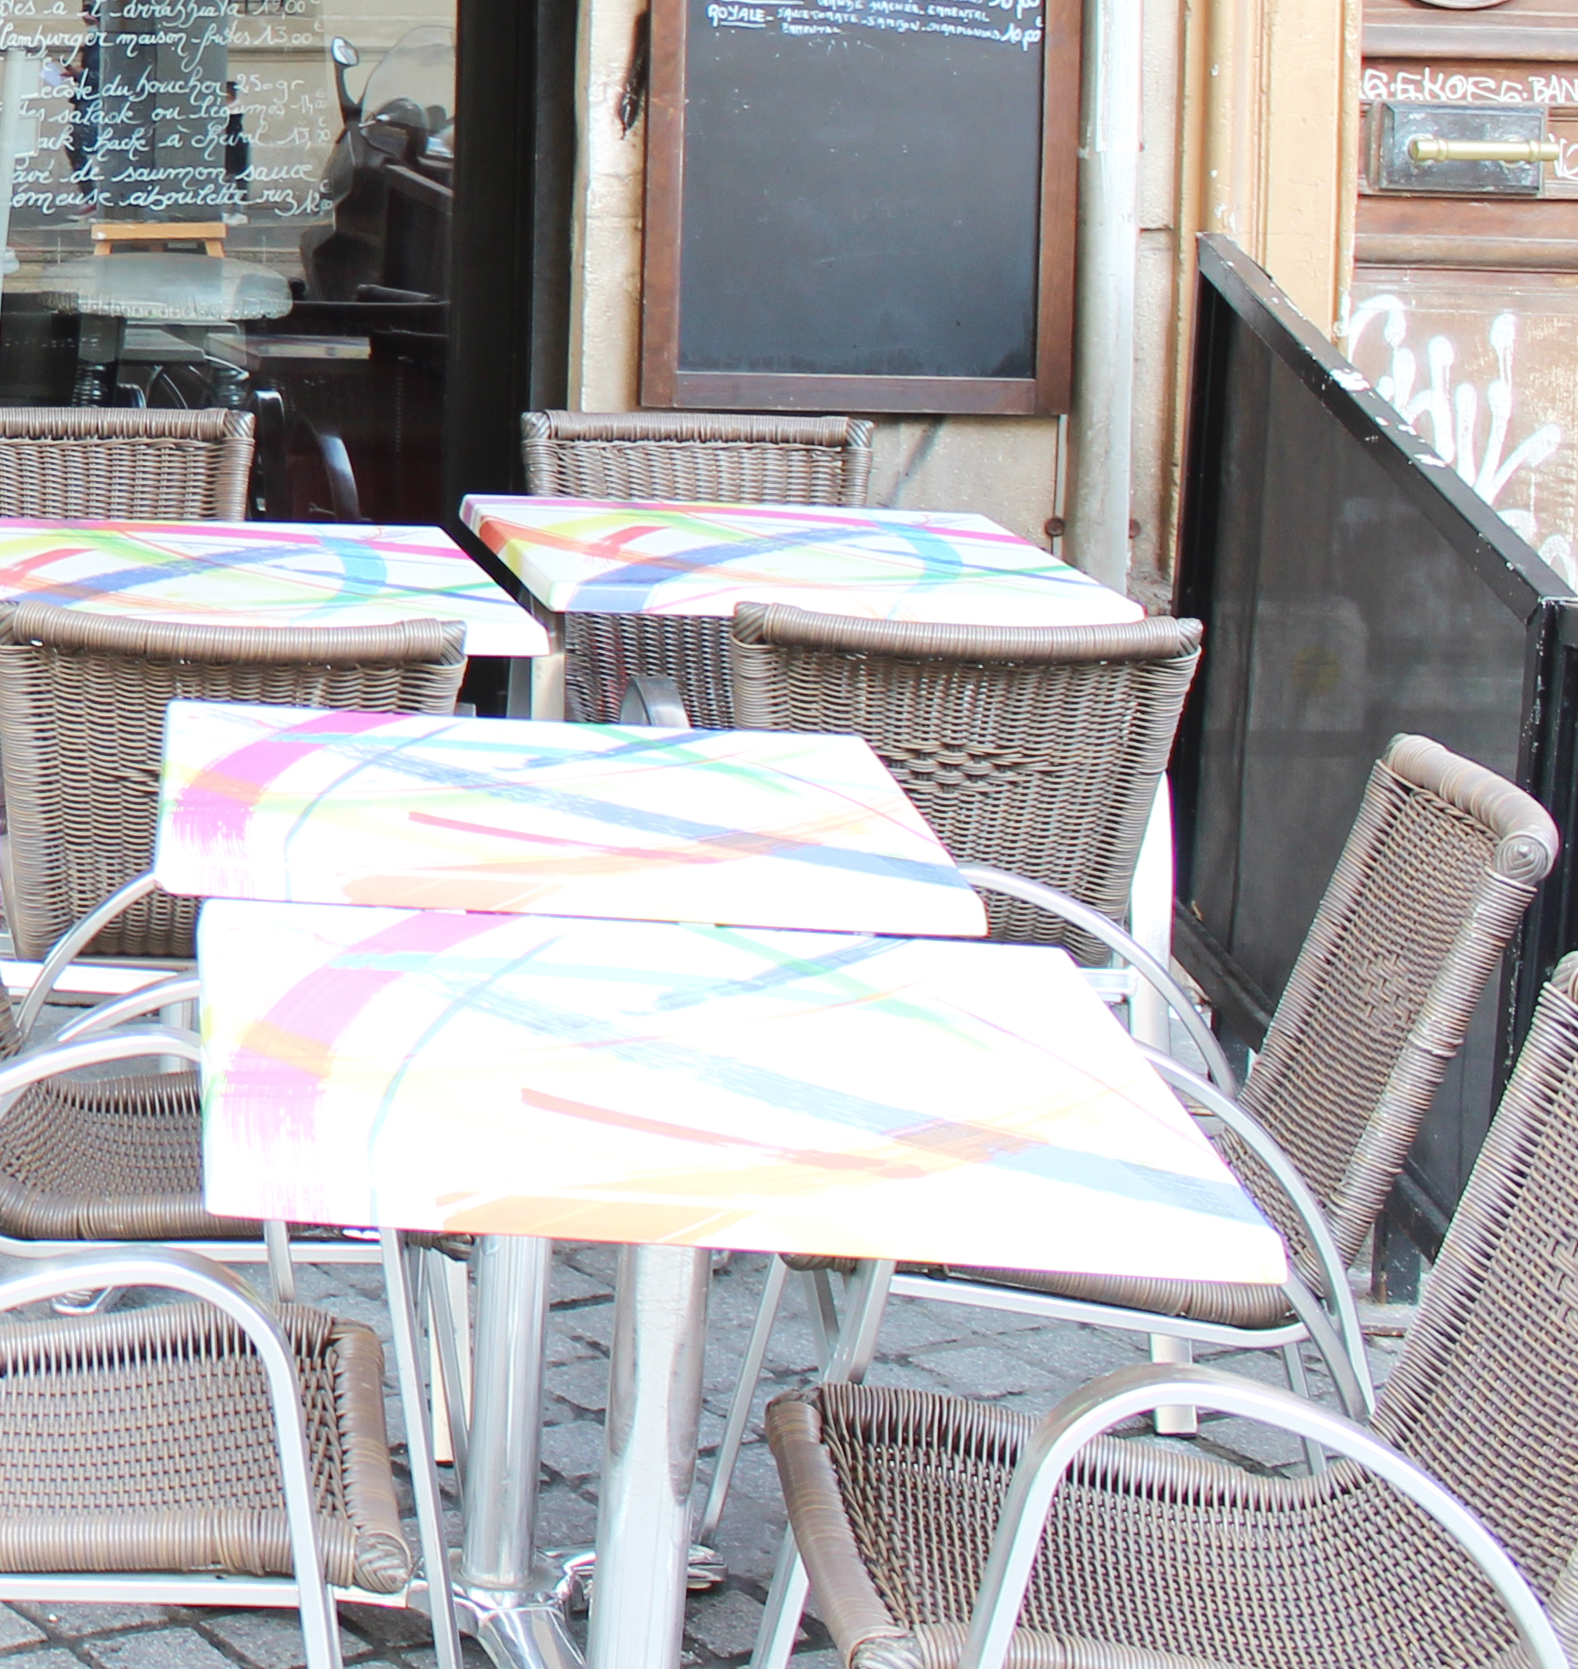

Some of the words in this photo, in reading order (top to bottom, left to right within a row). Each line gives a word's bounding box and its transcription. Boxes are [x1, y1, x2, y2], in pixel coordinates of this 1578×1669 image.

[707, 4, 765, 28] ROYALE
[115, 28, 187, 59] maison
[99, 75, 134, 99] du
[151, 106, 186, 121] ou
[69, 159, 105, 183] de
[111, 165, 227, 190] saumon
[234, 163, 315, 182] sauce
